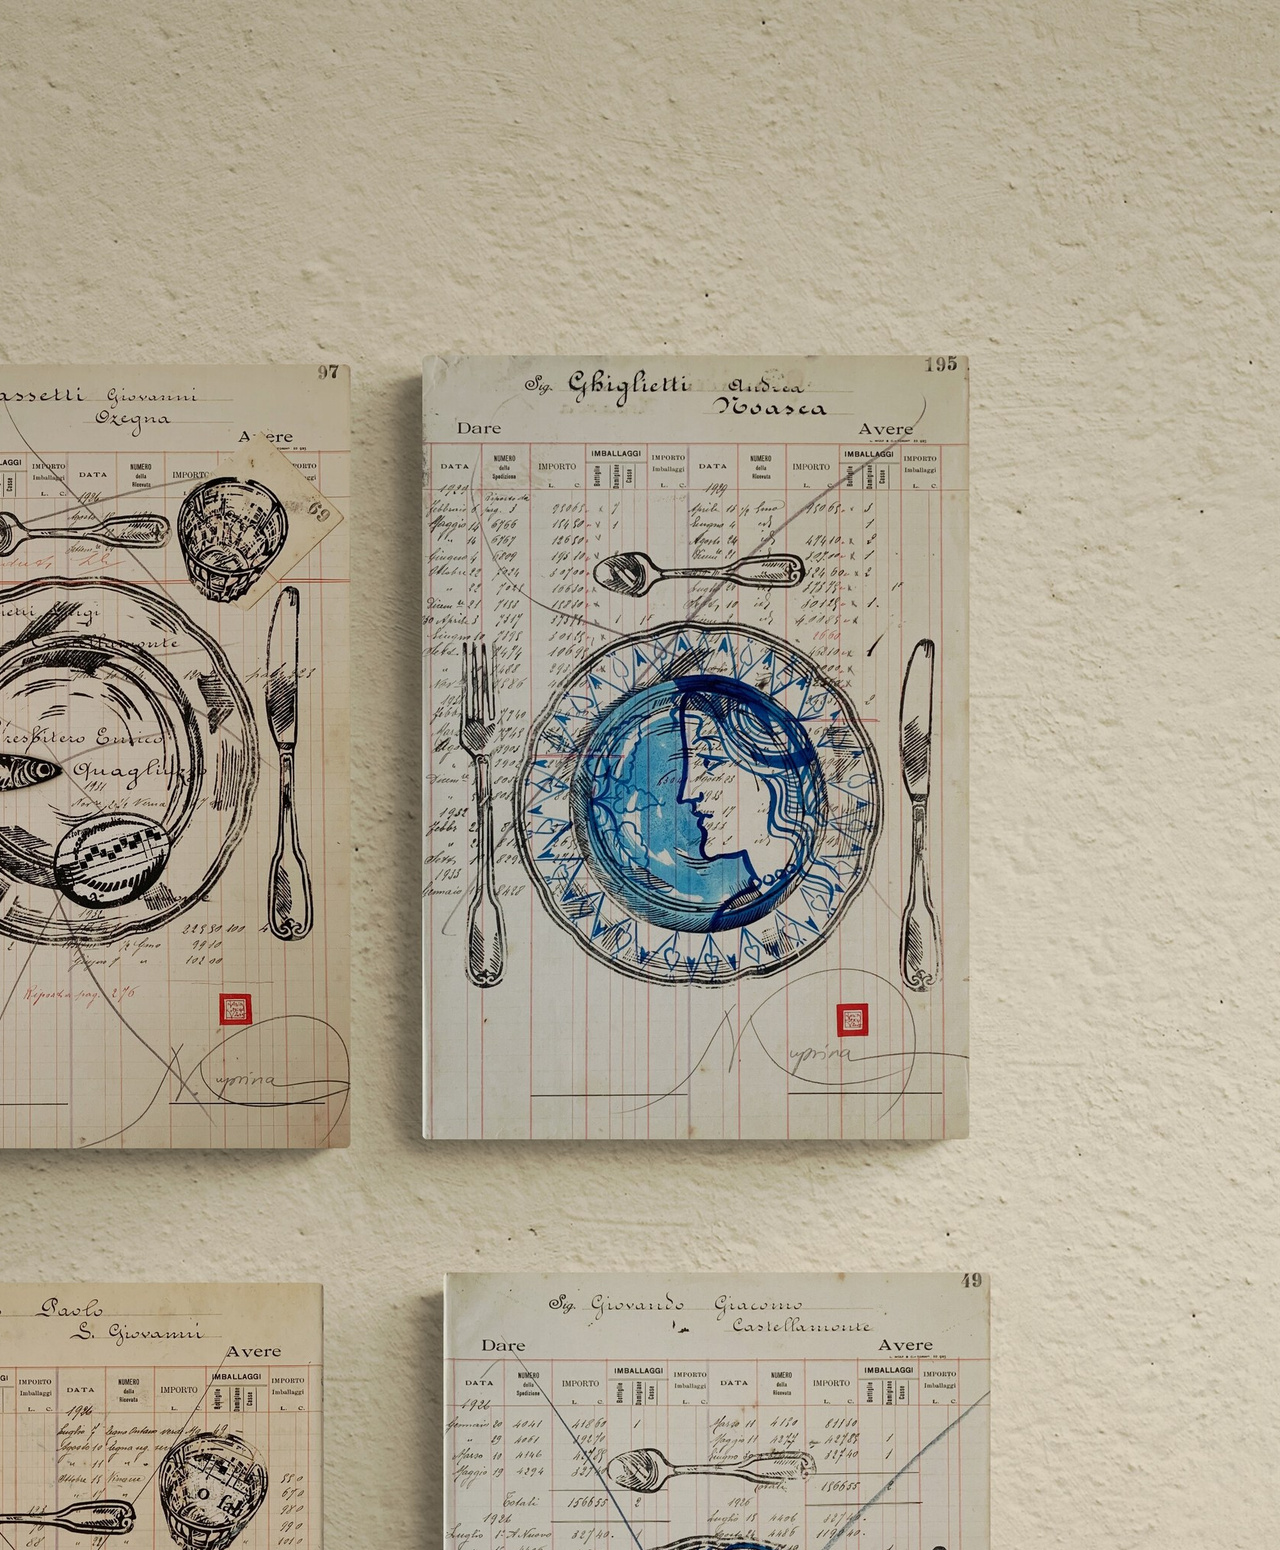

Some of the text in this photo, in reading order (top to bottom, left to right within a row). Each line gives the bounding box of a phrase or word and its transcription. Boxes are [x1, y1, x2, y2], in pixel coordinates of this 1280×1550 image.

[925, 356, 958, 372] 195
[318, 365, 338, 379] 97
[524, 374, 553, 395] Sig.
[568, 370, 688, 407] Ghiglietti
[108, 388, 197, 409] Giovanni
[712, 397, 827, 415] Noasca
[95, 410, 171, 437] Ozegna
[458, 422, 501, 434] Dare
[859, 423, 913, 435] Avere
[961, 1273, 982, 1288] 49
[36, 1297, 103, 1317] Paolo
[548, 1292, 803, 1320] Sig. Giovando Giacomo
[732, 1317, 871, 1332] Castellamonte
[109, 1323, 205, 1347] Giovanni
[226, 1346, 281, 1357] Avere
[482, 1339, 526, 1351] Dare
[879, 1339, 933, 1351] Avere
